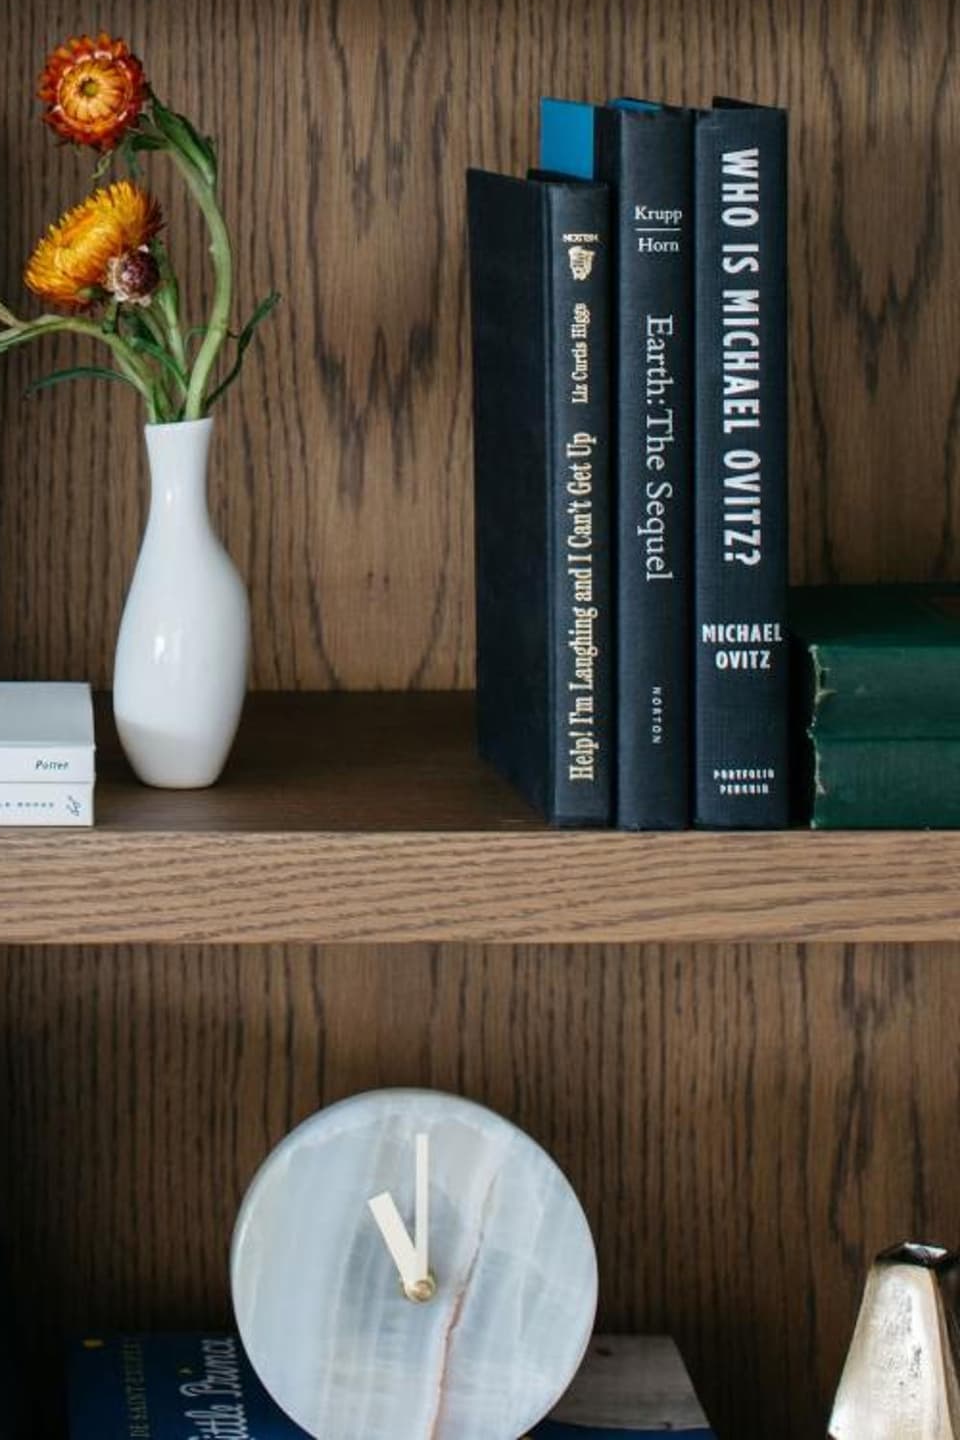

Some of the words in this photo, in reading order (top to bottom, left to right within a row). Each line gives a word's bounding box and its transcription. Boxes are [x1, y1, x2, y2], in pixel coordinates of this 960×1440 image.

[721, 147, 760, 228] WHO
[634, 205, 682, 225] Krupp
[637, 237, 680, 253] Horn
[721, 243, 760, 275] IS
[571, 302, 591, 339] Higgs
[571, 340, 589, 383] Curtis
[646, 314, 673, 405] Earth:
[722, 289, 761, 434] MICHAEL
[571, 383, 589, 405] Liz
[566, 431, 597, 459] Up
[646, 408, 674, 471] The
[566, 462, 592, 496] Get
[566, 500, 592, 549] Can't
[723, 449, 762, 567] OVITZ?
[637, 481, 673, 582] Sequel
[567, 554, 592, 563] I
[568, 567, 593, 602] and
[568, 606, 598, 692] Laughing
[701, 622, 783, 643] MICHAEL
[715, 650, 771, 669] OVITZ
[569, 695, 595, 725] I'm
[651, 686, 663, 744] NORTON
[34, 759, 70, 771] Potter
[569, 730, 600, 781] Help!
[712, 768, 775, 780] PORTFOLIO
